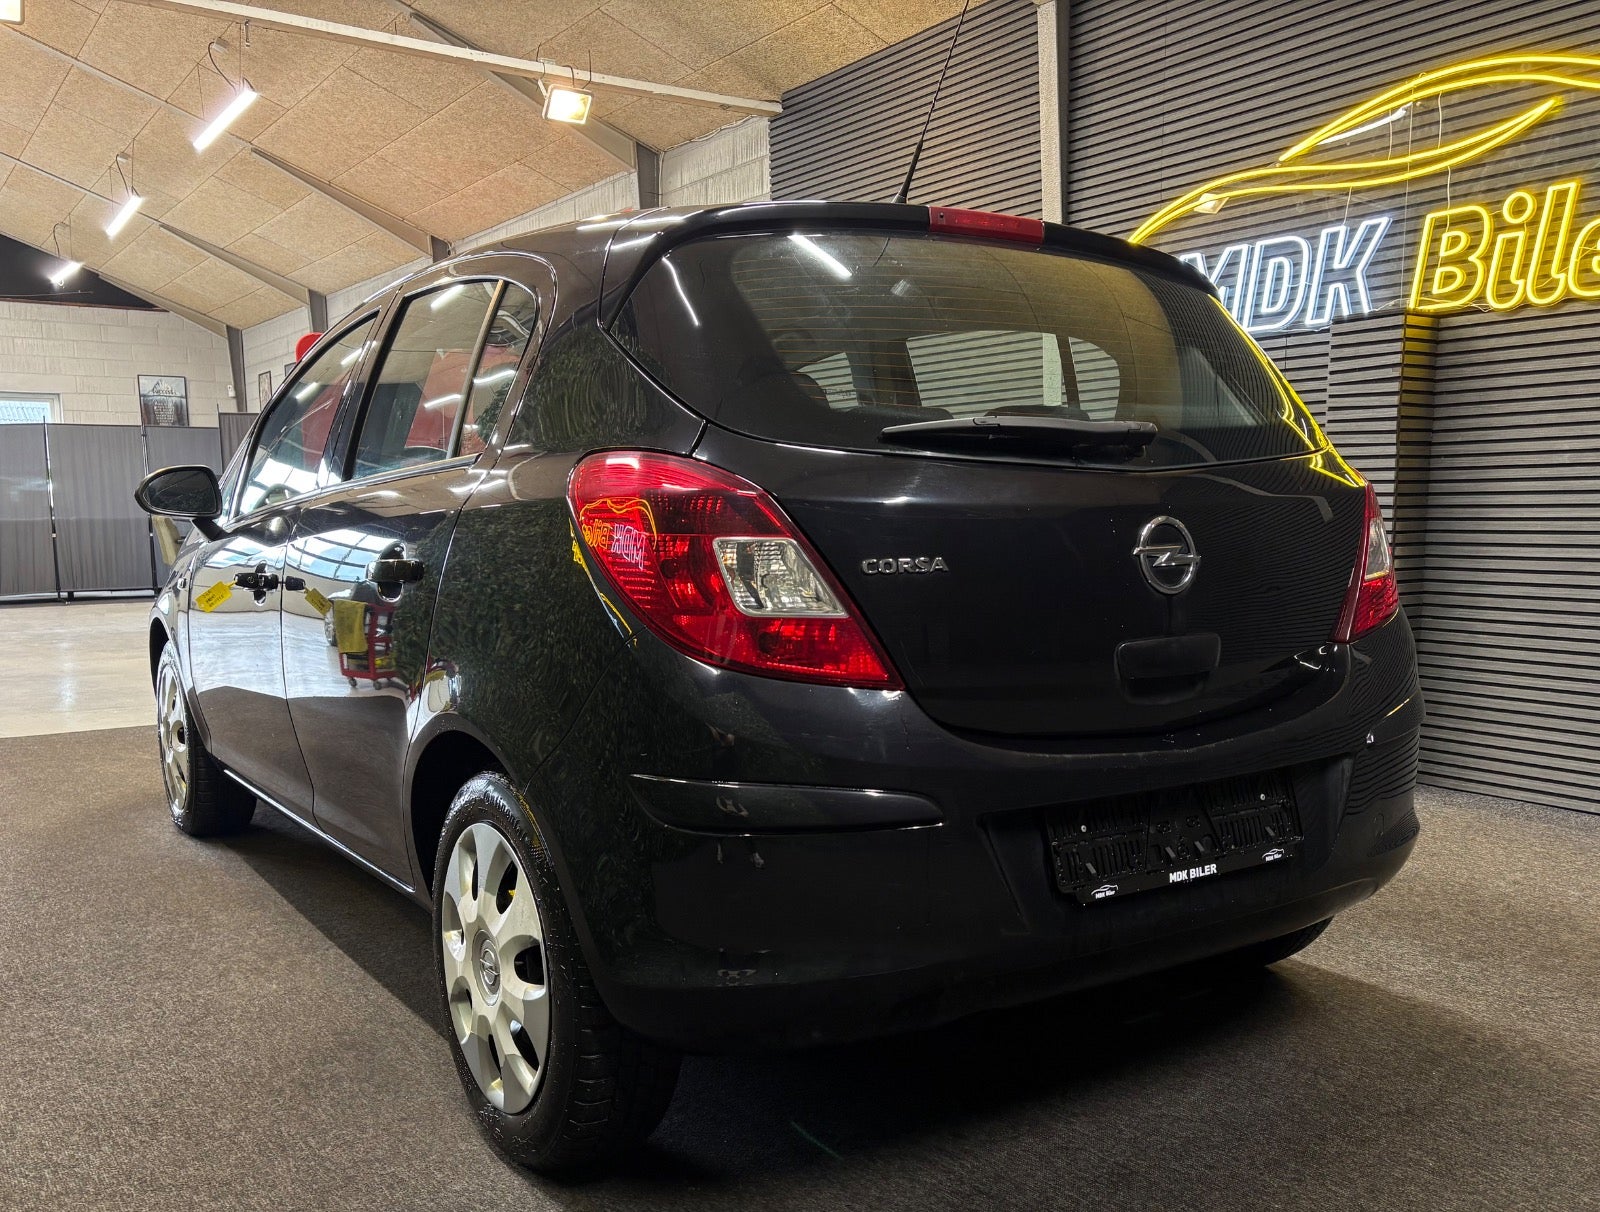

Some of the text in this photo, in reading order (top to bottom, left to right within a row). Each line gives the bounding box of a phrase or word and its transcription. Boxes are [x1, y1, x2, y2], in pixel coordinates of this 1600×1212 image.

[1179, 216, 1393, 332] MDK
[861, 556, 949, 576] CORSA
[1169, 863, 1217, 883] MDK BILER
